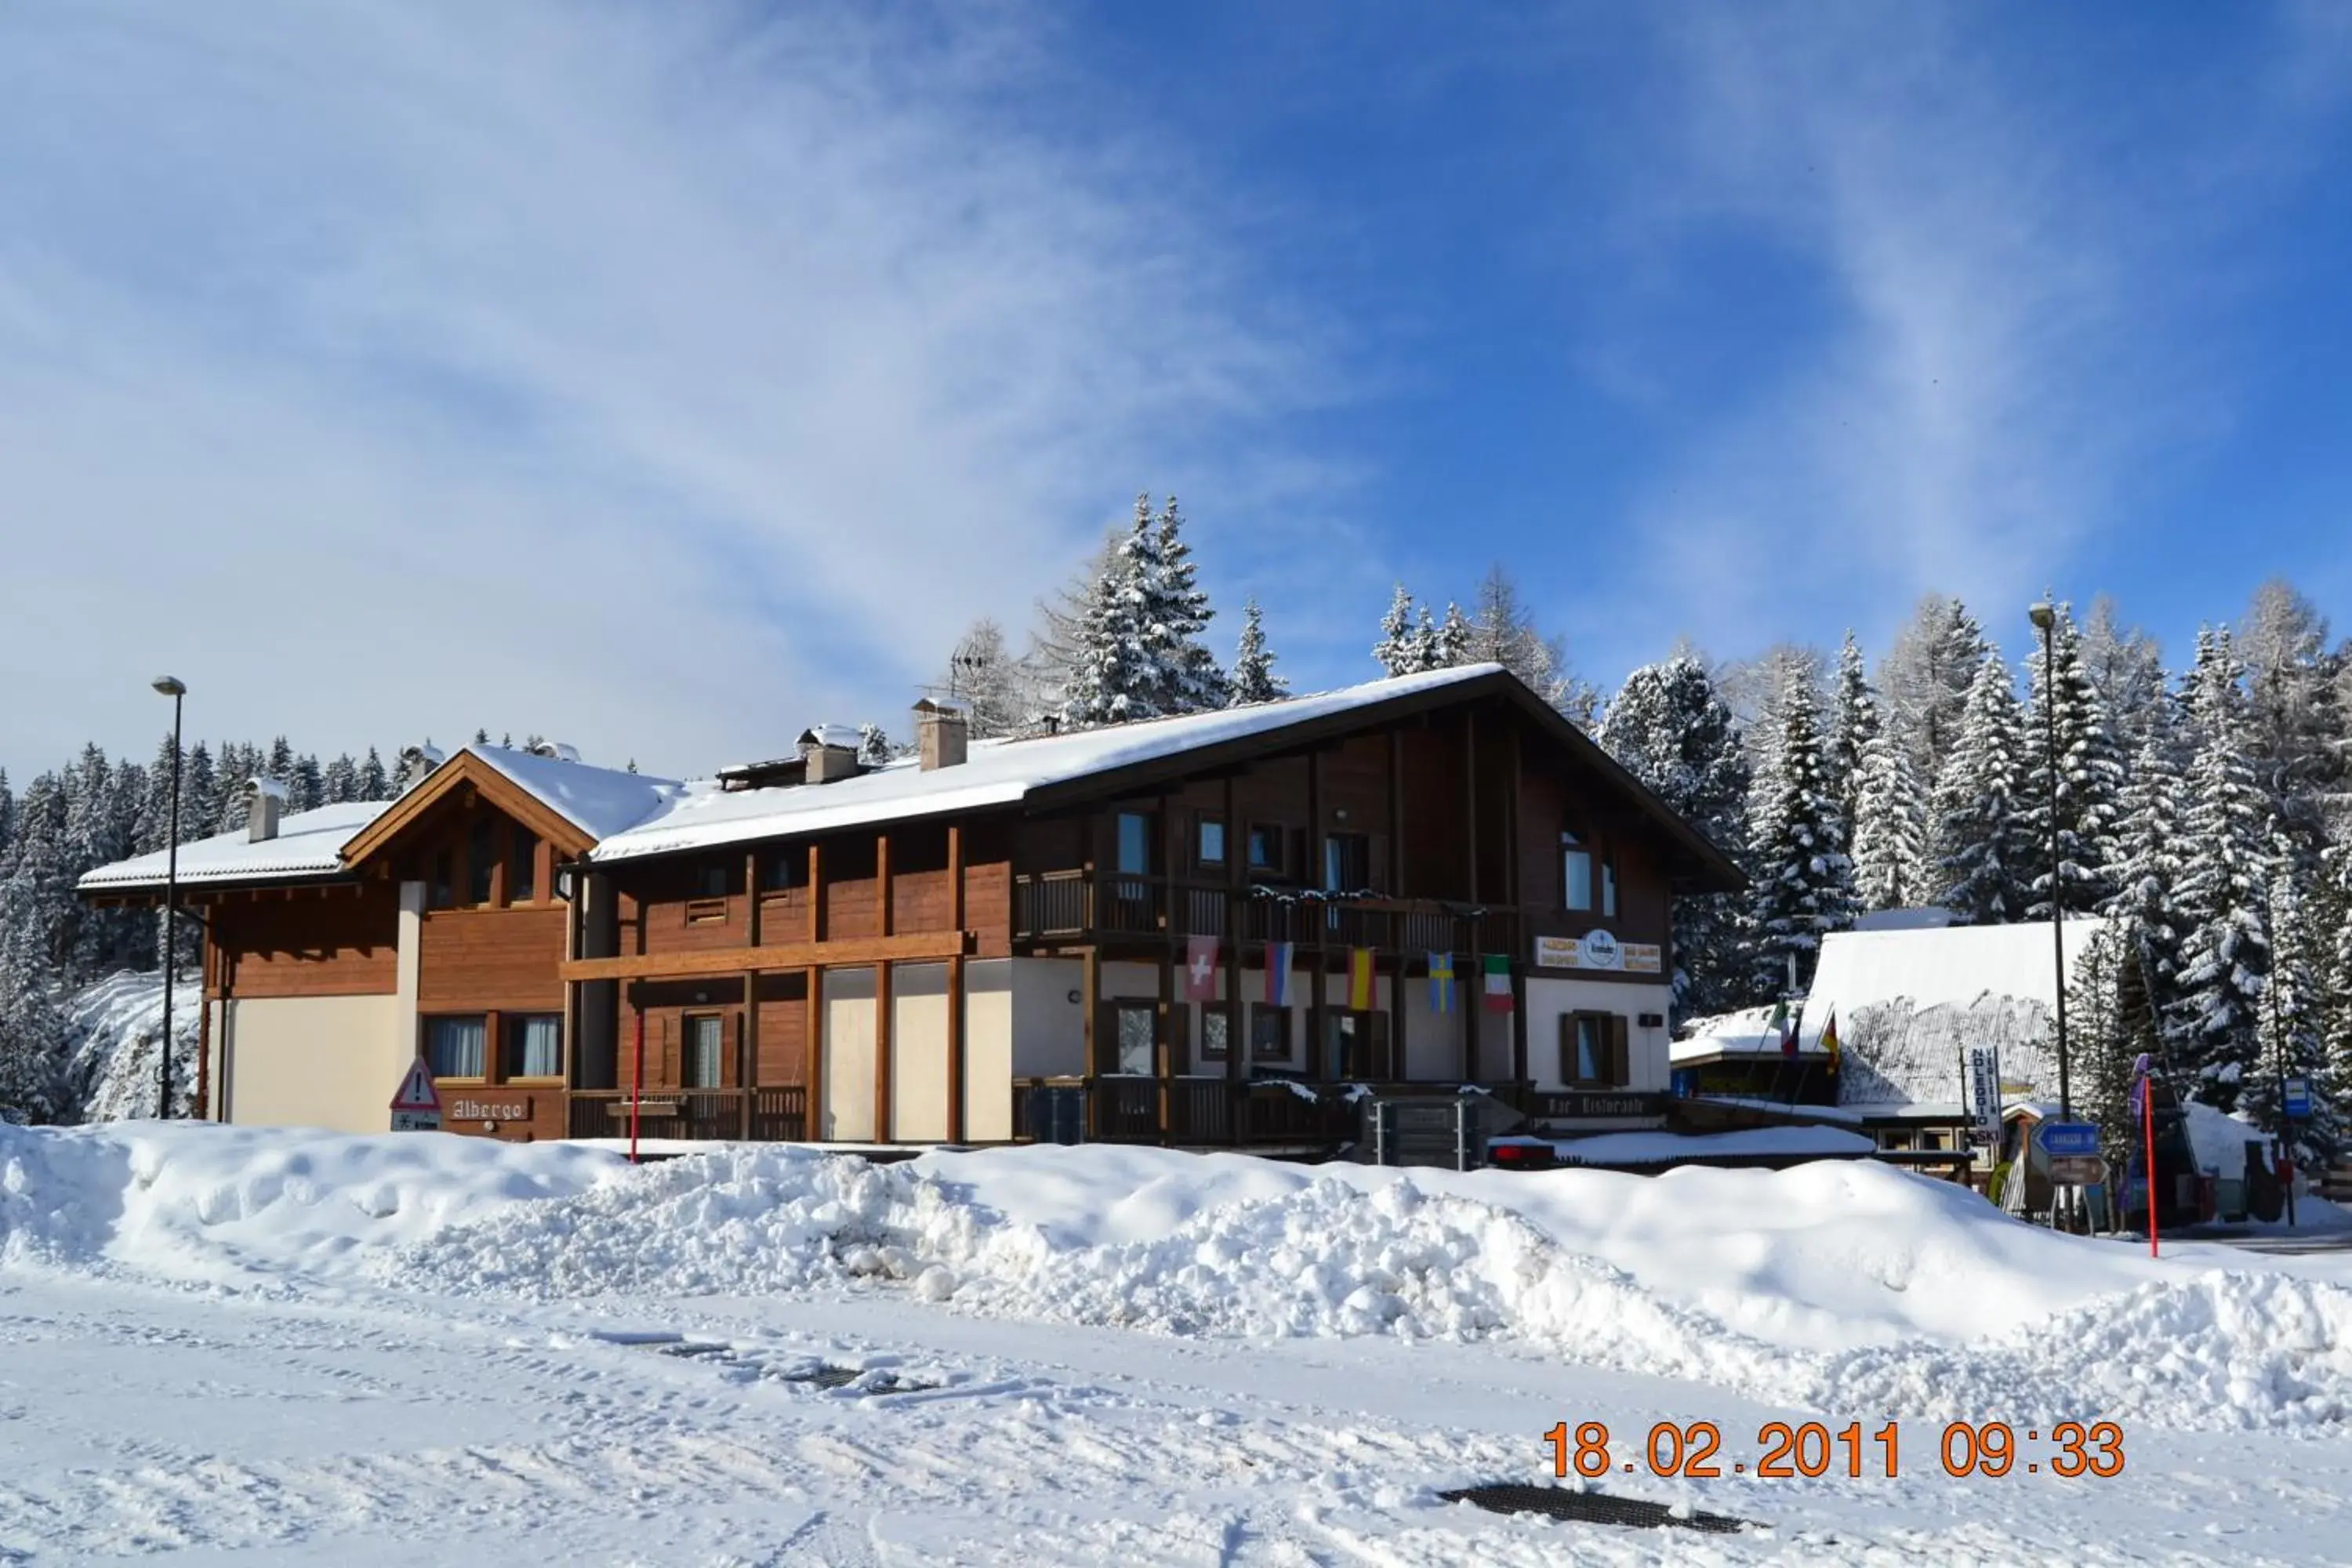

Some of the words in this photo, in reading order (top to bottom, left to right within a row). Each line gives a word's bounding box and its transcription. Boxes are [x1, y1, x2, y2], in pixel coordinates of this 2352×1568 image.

[1973, 1048, 1988, 1125] NOLEGGIO
[452, 1099, 522, 1120] Albergo
[1548, 1098, 1571, 1114] Bar
[1978, 1130, 1999, 1142] SKI
